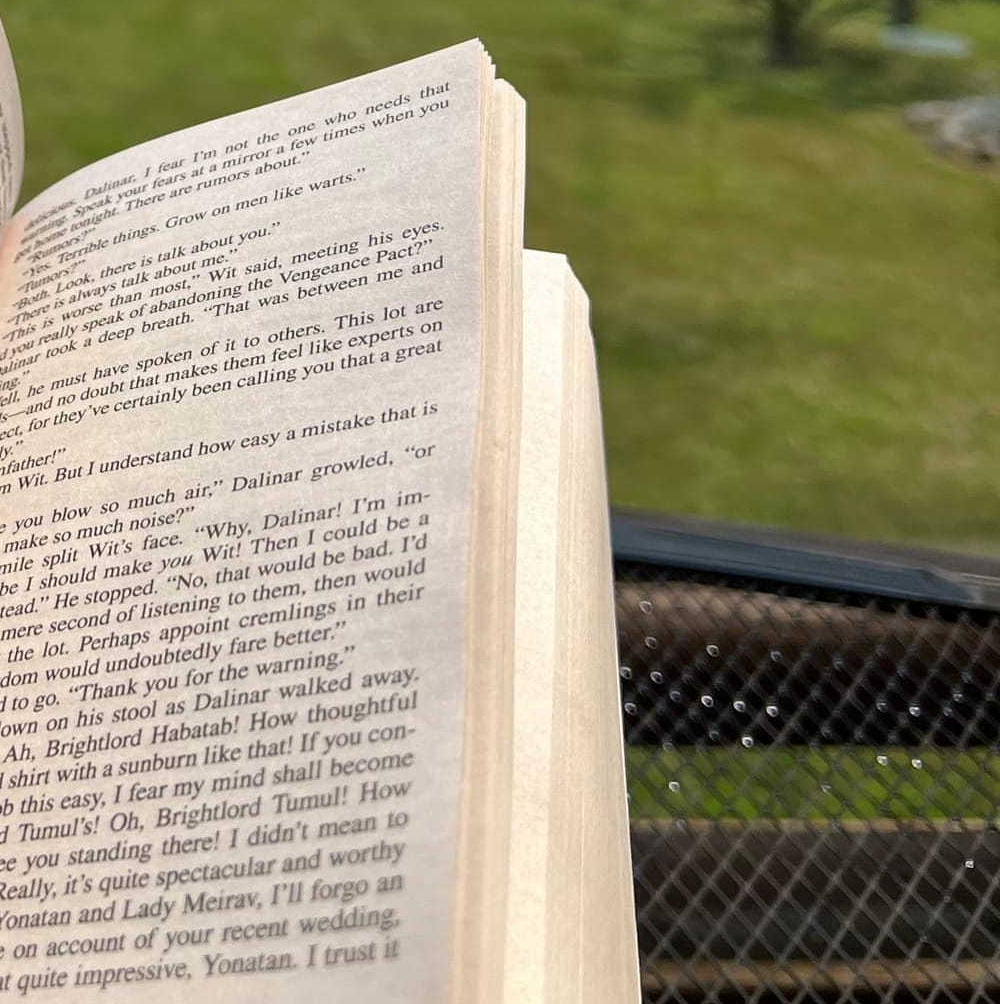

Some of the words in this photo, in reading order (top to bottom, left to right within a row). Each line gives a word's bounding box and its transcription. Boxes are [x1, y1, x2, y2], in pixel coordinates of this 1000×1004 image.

[58, 239, 109, 264] Terrible
[112, 224, 159, 244] things.
[165, 211, 207, 228] Grow
[211, 205, 230, 216] on
[235, 195, 267, 210] men
[273, 186, 303, 201] like
[308, 167, 366, 191] warts.”
[26, 384, 44, 397] he
[50, 371, 86, 390] must
[92, 363, 129, 380] have
[135, 350, 192, 372] spoken
[200, 340, 219, 356] of
[224, 338, 235, 352] it
[243, 336, 260, 348] to
[267, 324, 324, 343] others.
[334, 311, 374, 329] This
[383, 305, 406, 320] lot
[415, 299, 443, 314] are
[18, 472, 47, 489] Wit.
[53, 466, 82, 482] But
[86, 461, 94, 475] I
[99, 443, 193, 473] understand
[197, 439, 235, 455] how
[240, 432, 280, 448] easy
[285, 429, 295, 440] a
[301, 414, 374, 437] mistake
[381, 406, 415, 423] that
[422, 400, 437, 415] is
[41, 547, 77, 570] split
[88, 539, 132, 558] Wit’s
[142, 534, 182, 550] face.
[195, 521, 251, 539] “Why,
[262, 501, 341, 530] Dalinar!
[353, 497, 384, 514] I’m
[396, 491, 429, 506] im-
[11, 696, 29, 711] to
[32, 693, 59, 712] go.
[68, 677, 137, 701] “Thank
[142, 676, 178, 697] you
[184, 668, 213, 687] for
[218, 663, 248, 682] the
[255, 645, 355, 676] warning.”
[45, 716, 68, 731] on
[75, 707, 103, 727] his
[111, 699, 157, 723] stool
[165, 700, 185, 715] as
[193, 688, 270, 711] Dalinar
[278, 671, 351, 699] walked
[361, 668, 418, 688] away.
[77, 900, 116, 924] and
[121, 896, 174, 922] Lady
[182, 890, 261, 914] Meirav,
[270, 881, 302, 905] I’ll
[310, 878, 368, 904] forgo
[376, 874, 403, 894] an
[16, 966, 68, 995] quite
[73, 957, 191, 990] impressive,
[203, 953, 296, 976] Yonatan.
[306, 943, 317, 968] I
[324, 942, 376, 966] trust
[383, 935, 399, 959] it
